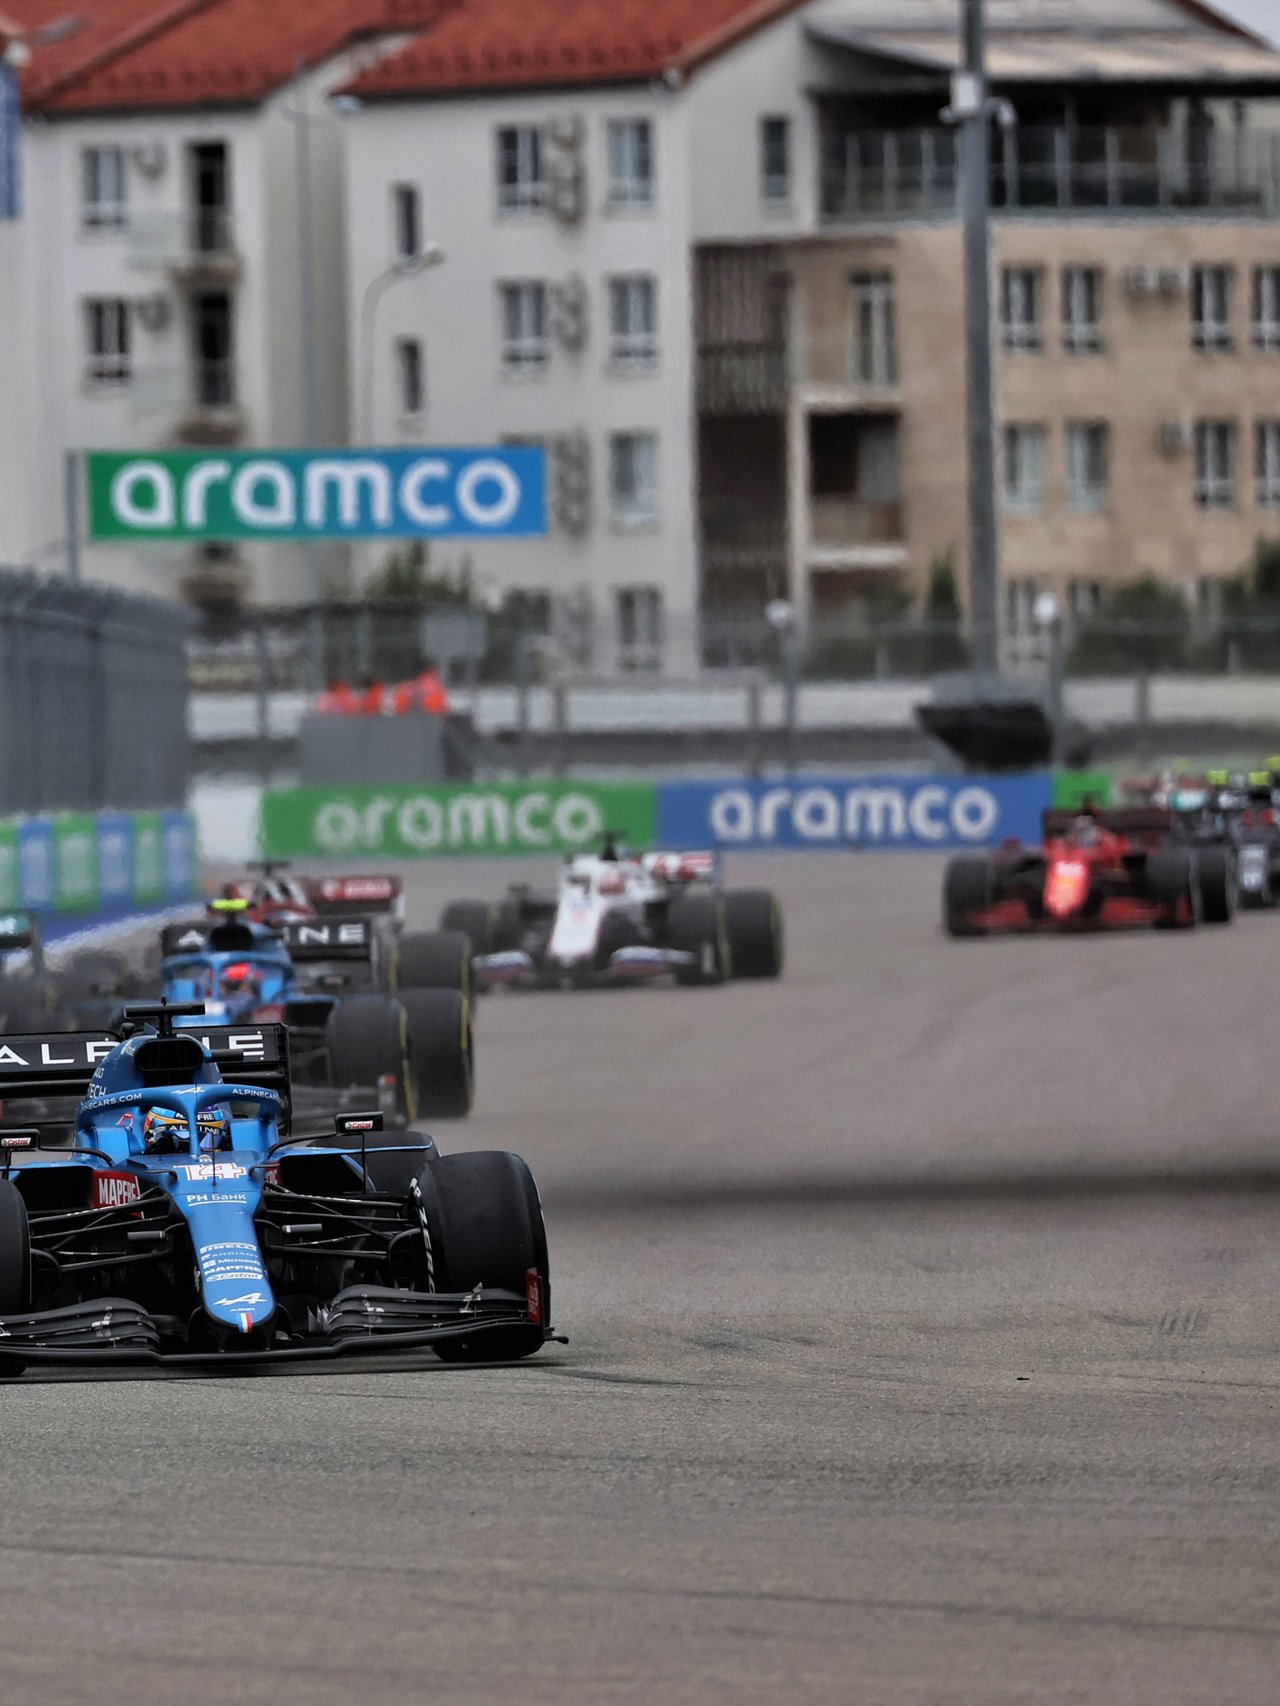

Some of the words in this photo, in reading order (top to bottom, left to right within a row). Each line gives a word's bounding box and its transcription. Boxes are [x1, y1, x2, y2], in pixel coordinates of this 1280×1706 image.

[111, 459, 521, 527] aramco
[314, 793, 603, 849] aramco
[710, 785, 997, 840] aramco
